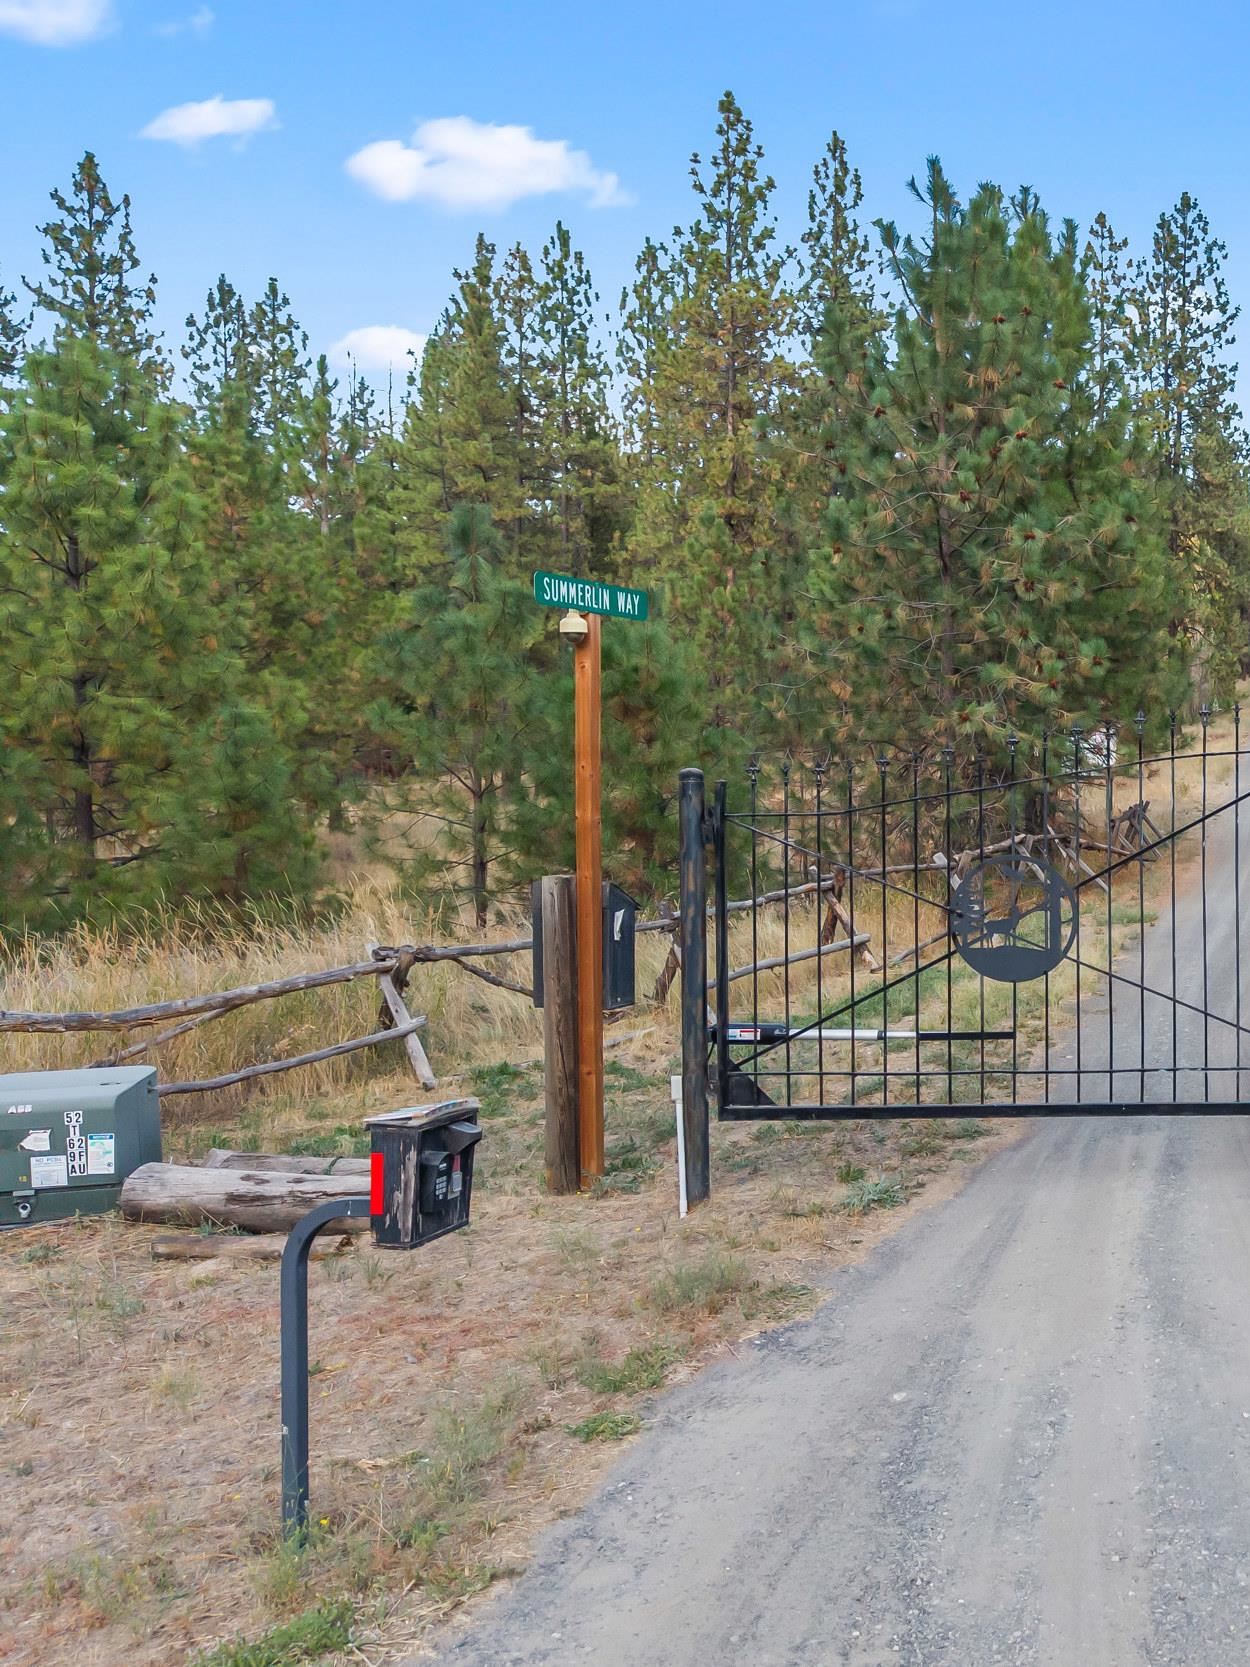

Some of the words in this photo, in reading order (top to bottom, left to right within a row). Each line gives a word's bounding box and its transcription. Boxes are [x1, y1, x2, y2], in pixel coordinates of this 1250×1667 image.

[543, 577, 610, 610] SUMMERLIN
[617, 591, 640, 615] WAY
[65, 1112, 82, 1123] 52
[71, 1125, 78, 1136] T
[68, 1138, 84, 1149] 62
[69, 1150, 84, 1161] 9F
[71, 1164, 86, 1174] AU
